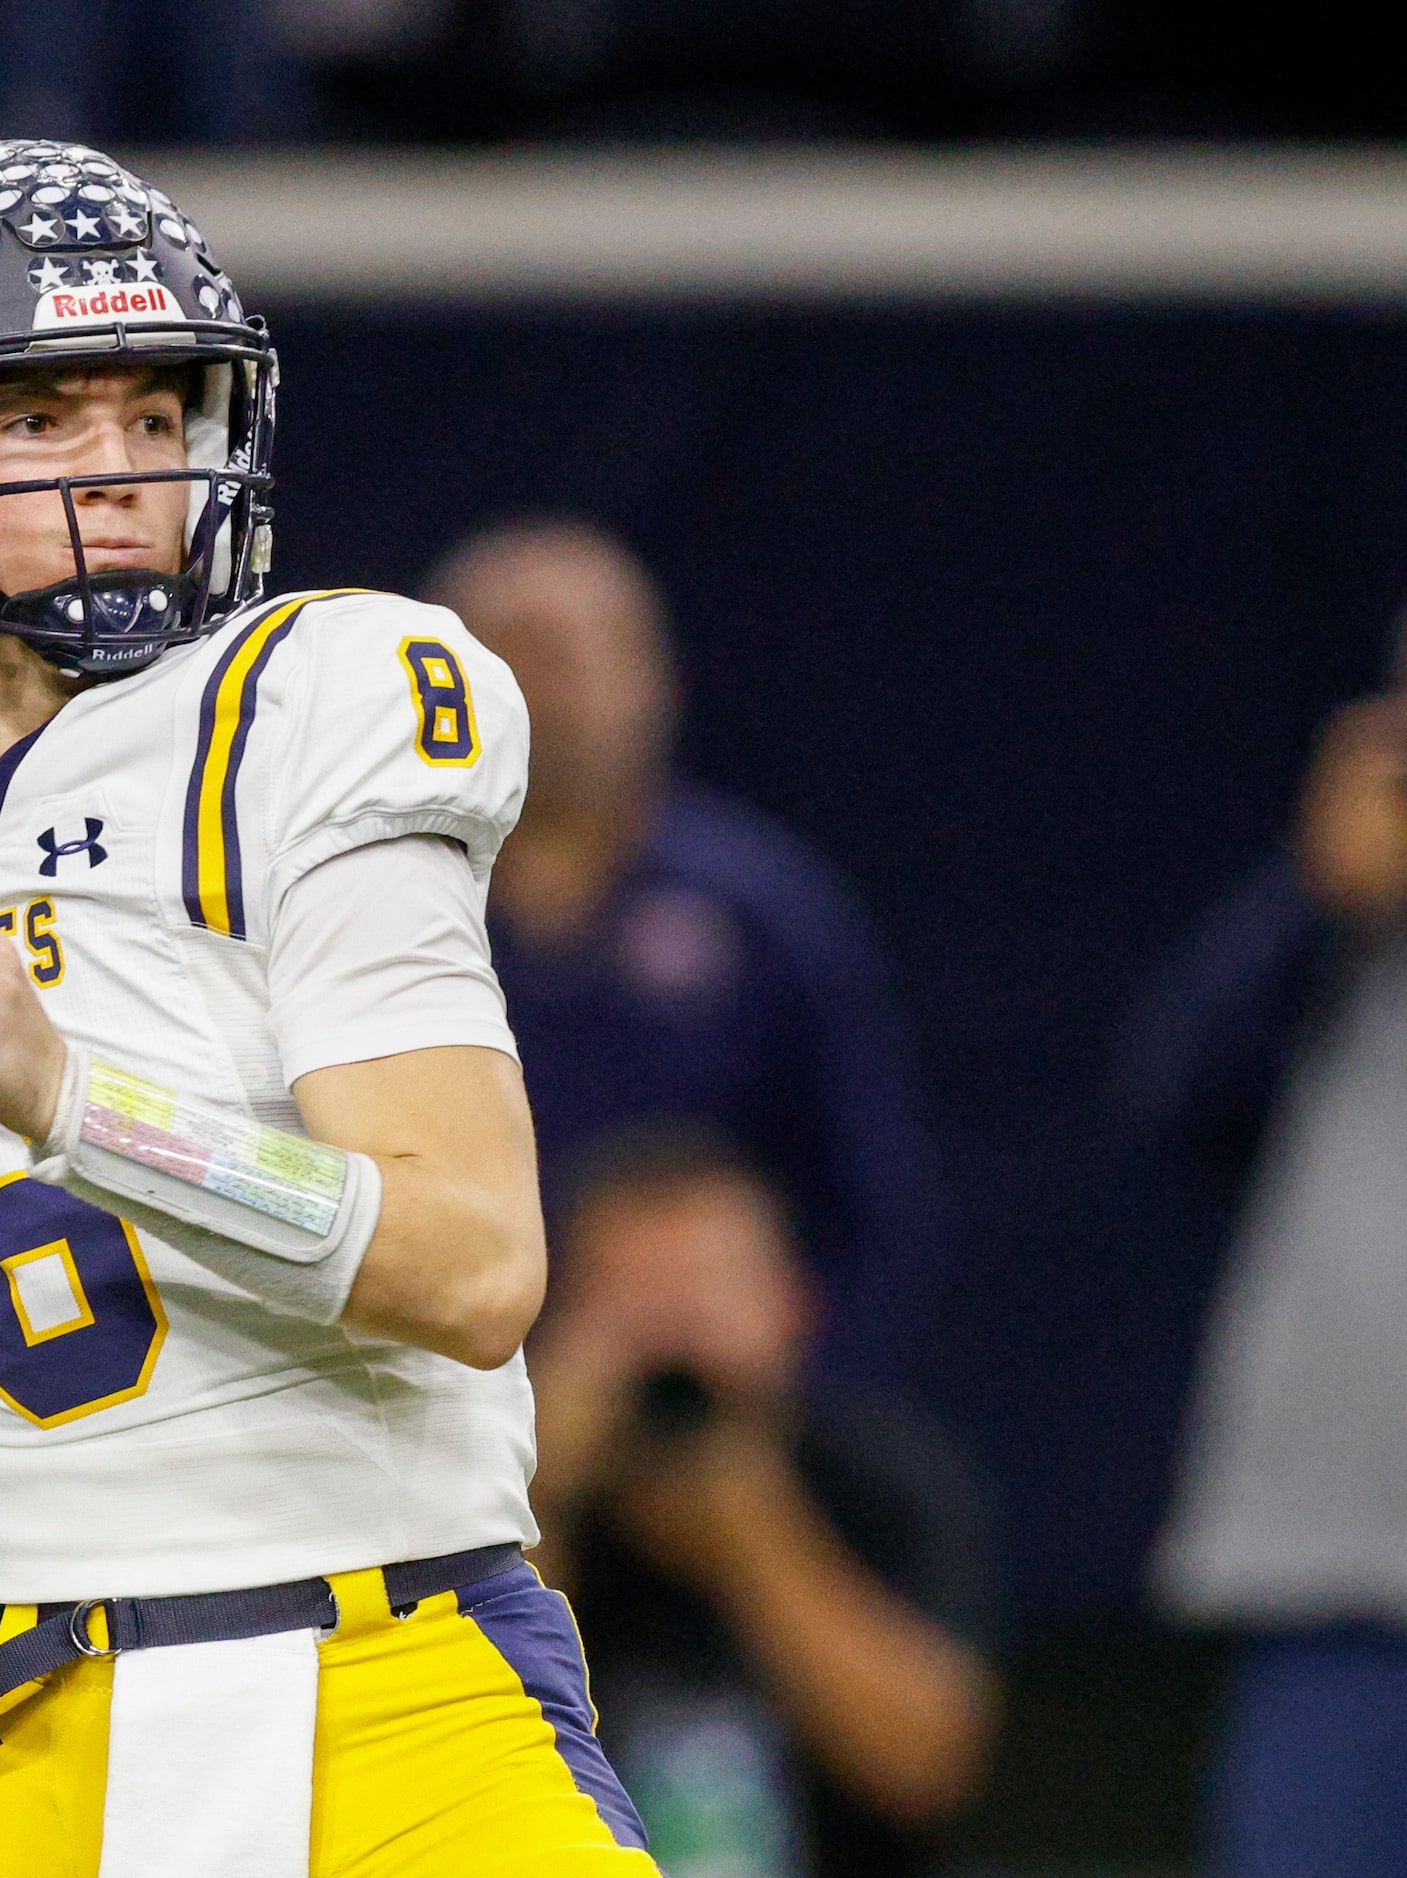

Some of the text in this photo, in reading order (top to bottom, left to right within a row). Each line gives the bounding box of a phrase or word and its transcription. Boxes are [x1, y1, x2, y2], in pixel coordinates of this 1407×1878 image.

[53, 288, 166, 318] Riddell
[92, 643, 153, 661] Riddell
[396, 635, 483, 768] 8
